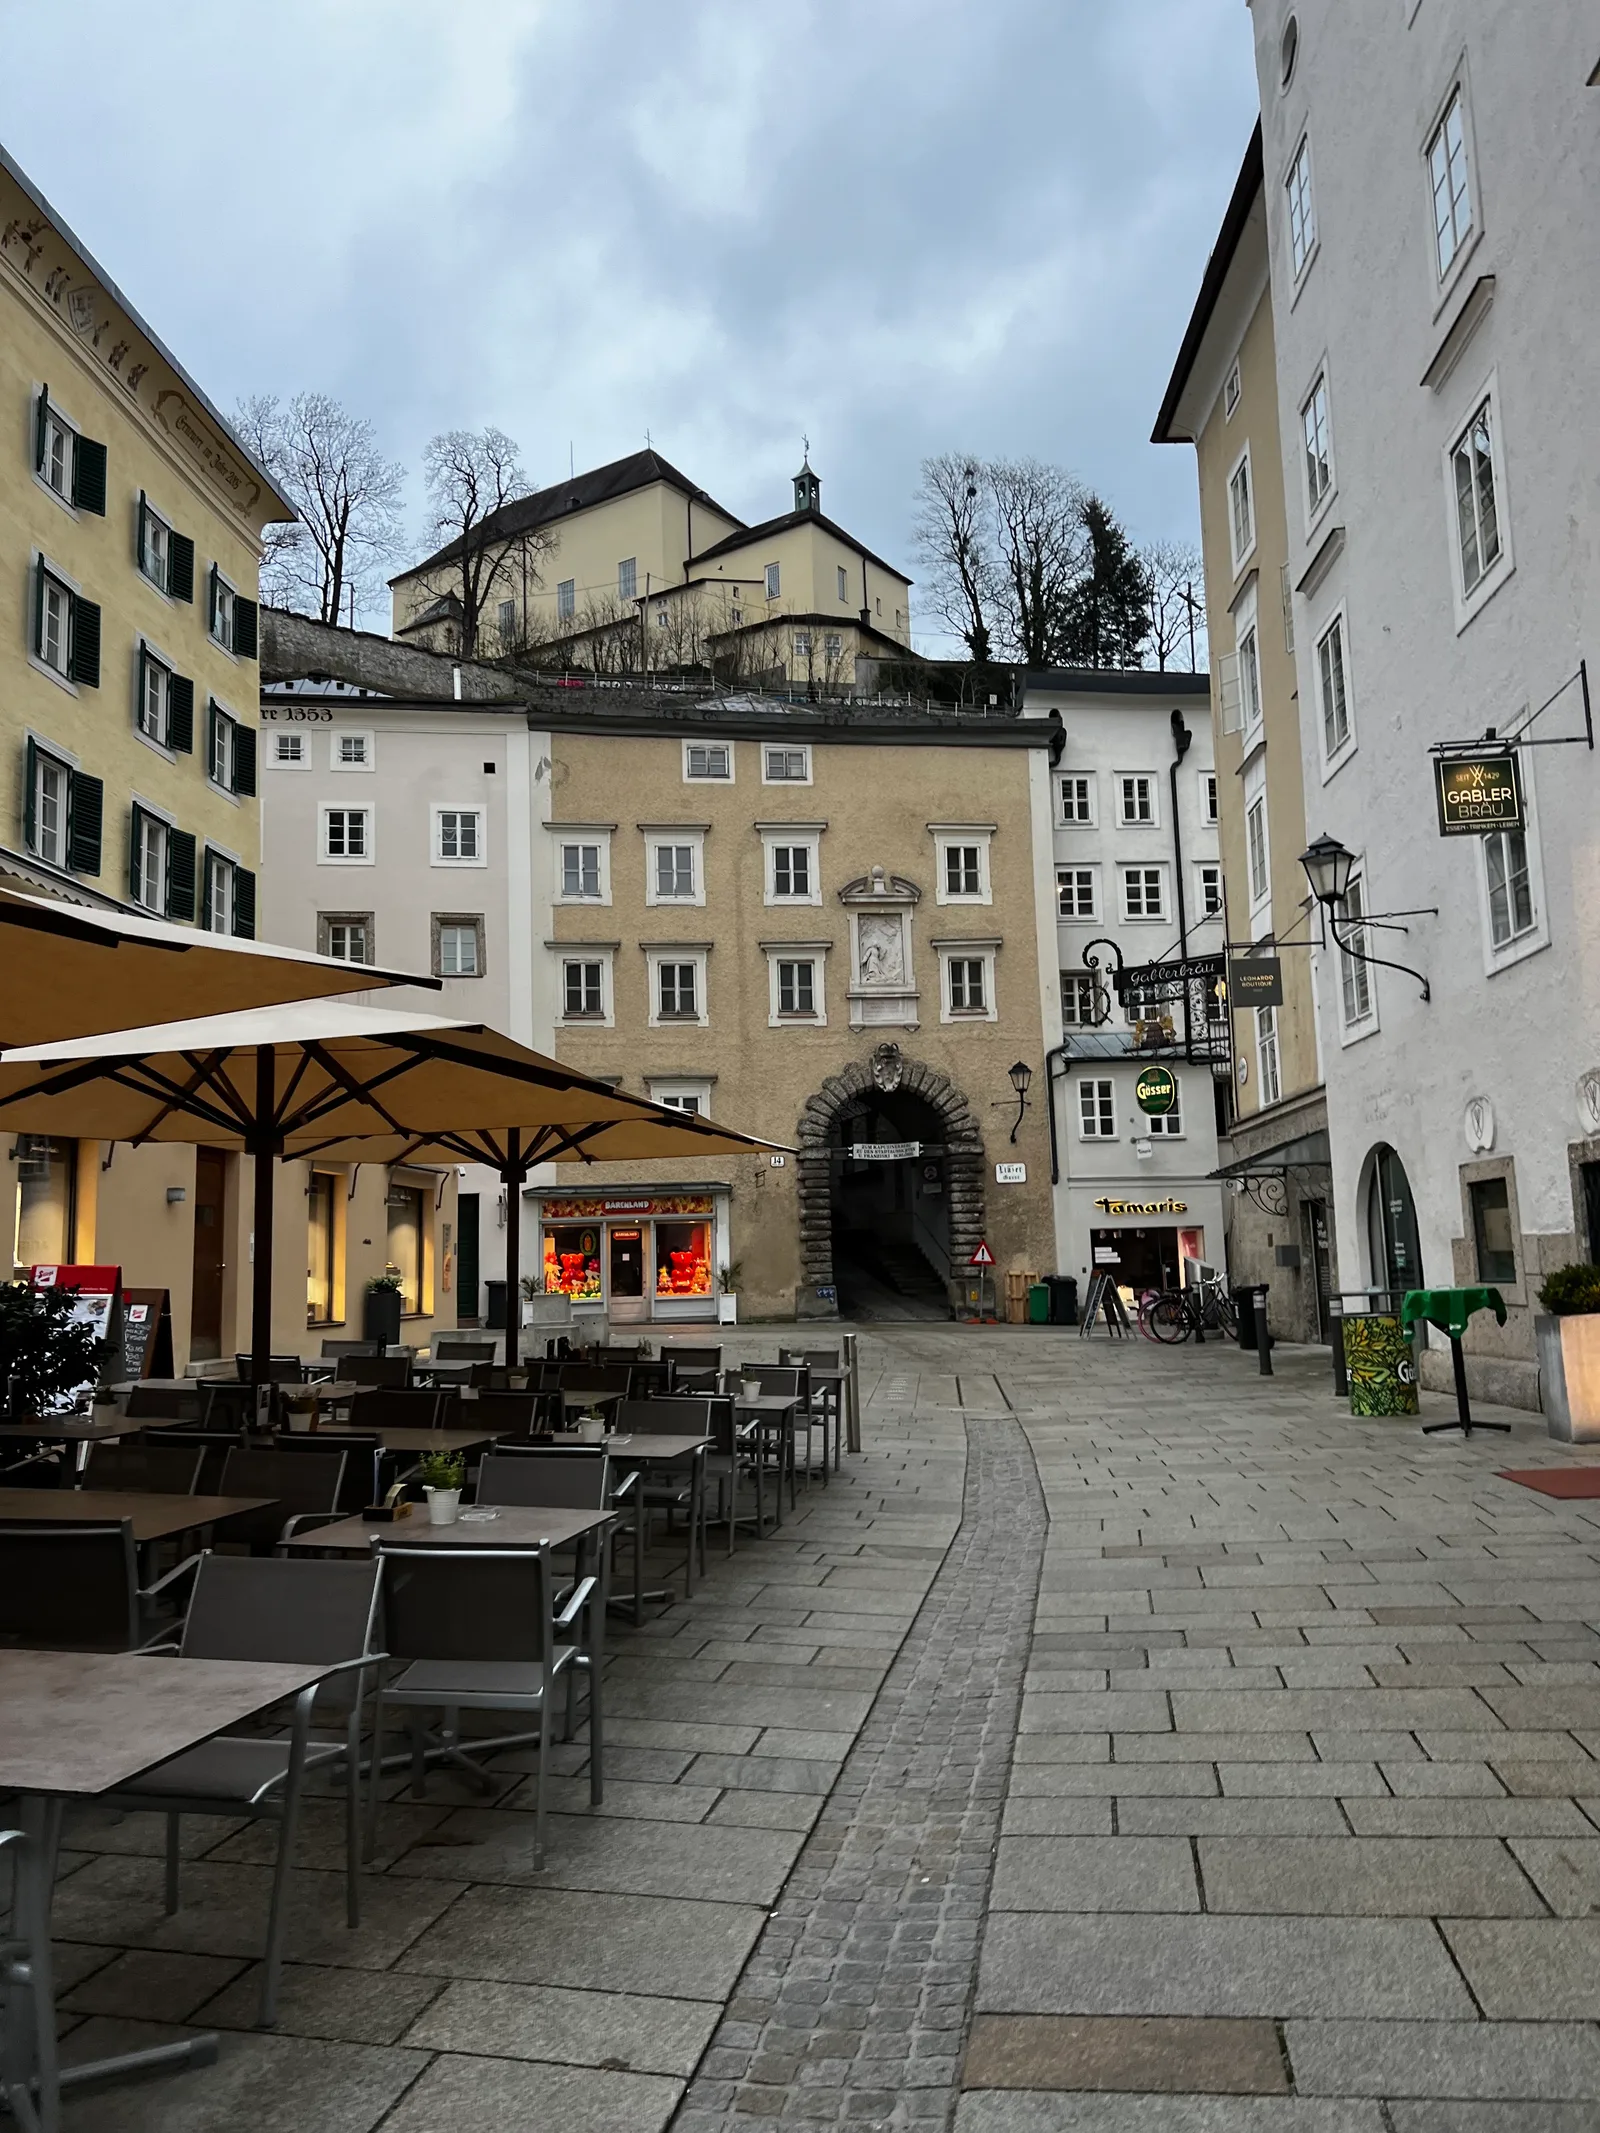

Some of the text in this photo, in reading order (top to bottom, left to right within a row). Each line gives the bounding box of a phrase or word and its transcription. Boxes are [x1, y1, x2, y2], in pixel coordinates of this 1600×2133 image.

[283, 708, 333, 722] 1353
[1455, 774, 1470, 783] SEIT
[1447, 787, 1512, 804] GABLER
[1458, 802, 1504, 818] BRÄU
[1137, 1082, 1171, 1100] Gösser
[1094, 1196, 1188, 1214] Tamaris
